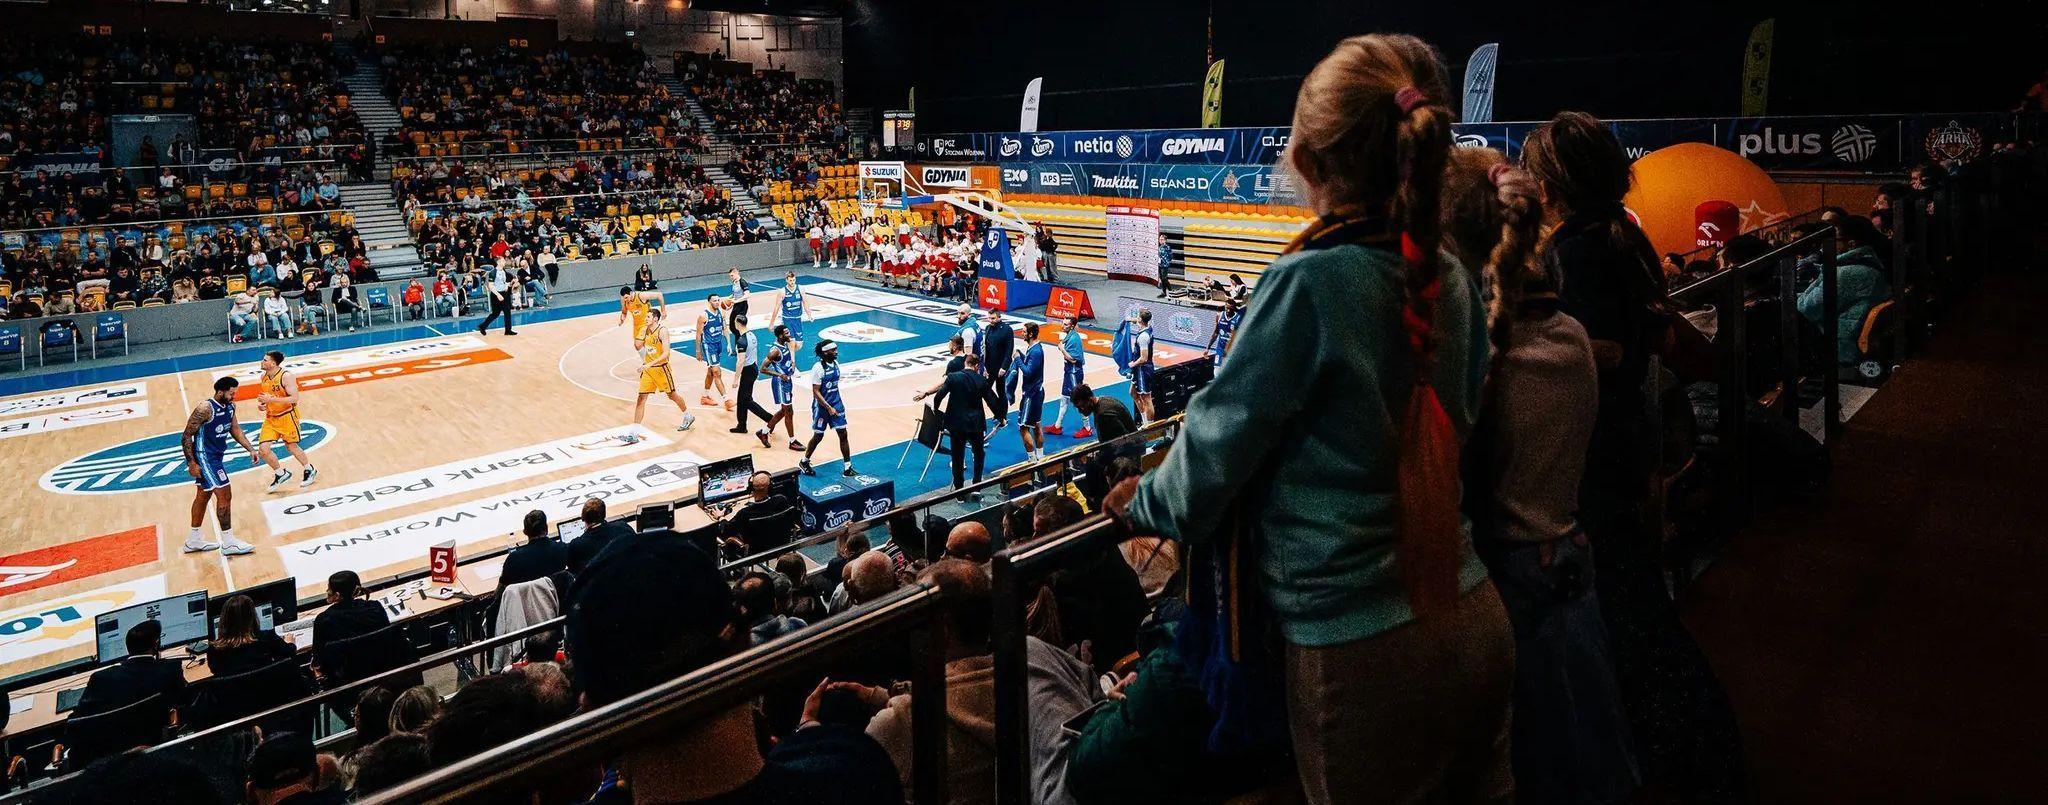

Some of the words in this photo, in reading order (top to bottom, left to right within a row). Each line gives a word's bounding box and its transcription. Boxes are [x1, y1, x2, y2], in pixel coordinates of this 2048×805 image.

[944, 139, 955, 147] PGZ
[1075, 137, 1113, 153] netia
[1162, 137, 1225, 155] GDYNIA
[1739, 126, 1821, 157] plus
[872, 168, 898, 176] SUZUKI
[925, 169, 967, 183] GDYNIA
[1004, 169, 1028, 182] EXO
[1043, 175, 1057, 183] APS
[1151, 177, 1209, 189] SCAN3D
[983, 260, 994, 269] plus
[985, 297, 1000, 305] ORLEN
[298, 367, 404, 387] ORLE
[445, 452, 554, 482] Bank
[283, 478, 434, 515] Pekao
[481, 474, 621, 511] STOCZNIA
[560, 483, 636, 509] PGZ
[868, 501, 886, 515] LOTTO
[829, 513, 849, 527] LOTTO
[299, 510, 478, 555] WOJENNA
[433, 550, 448, 573] 5
